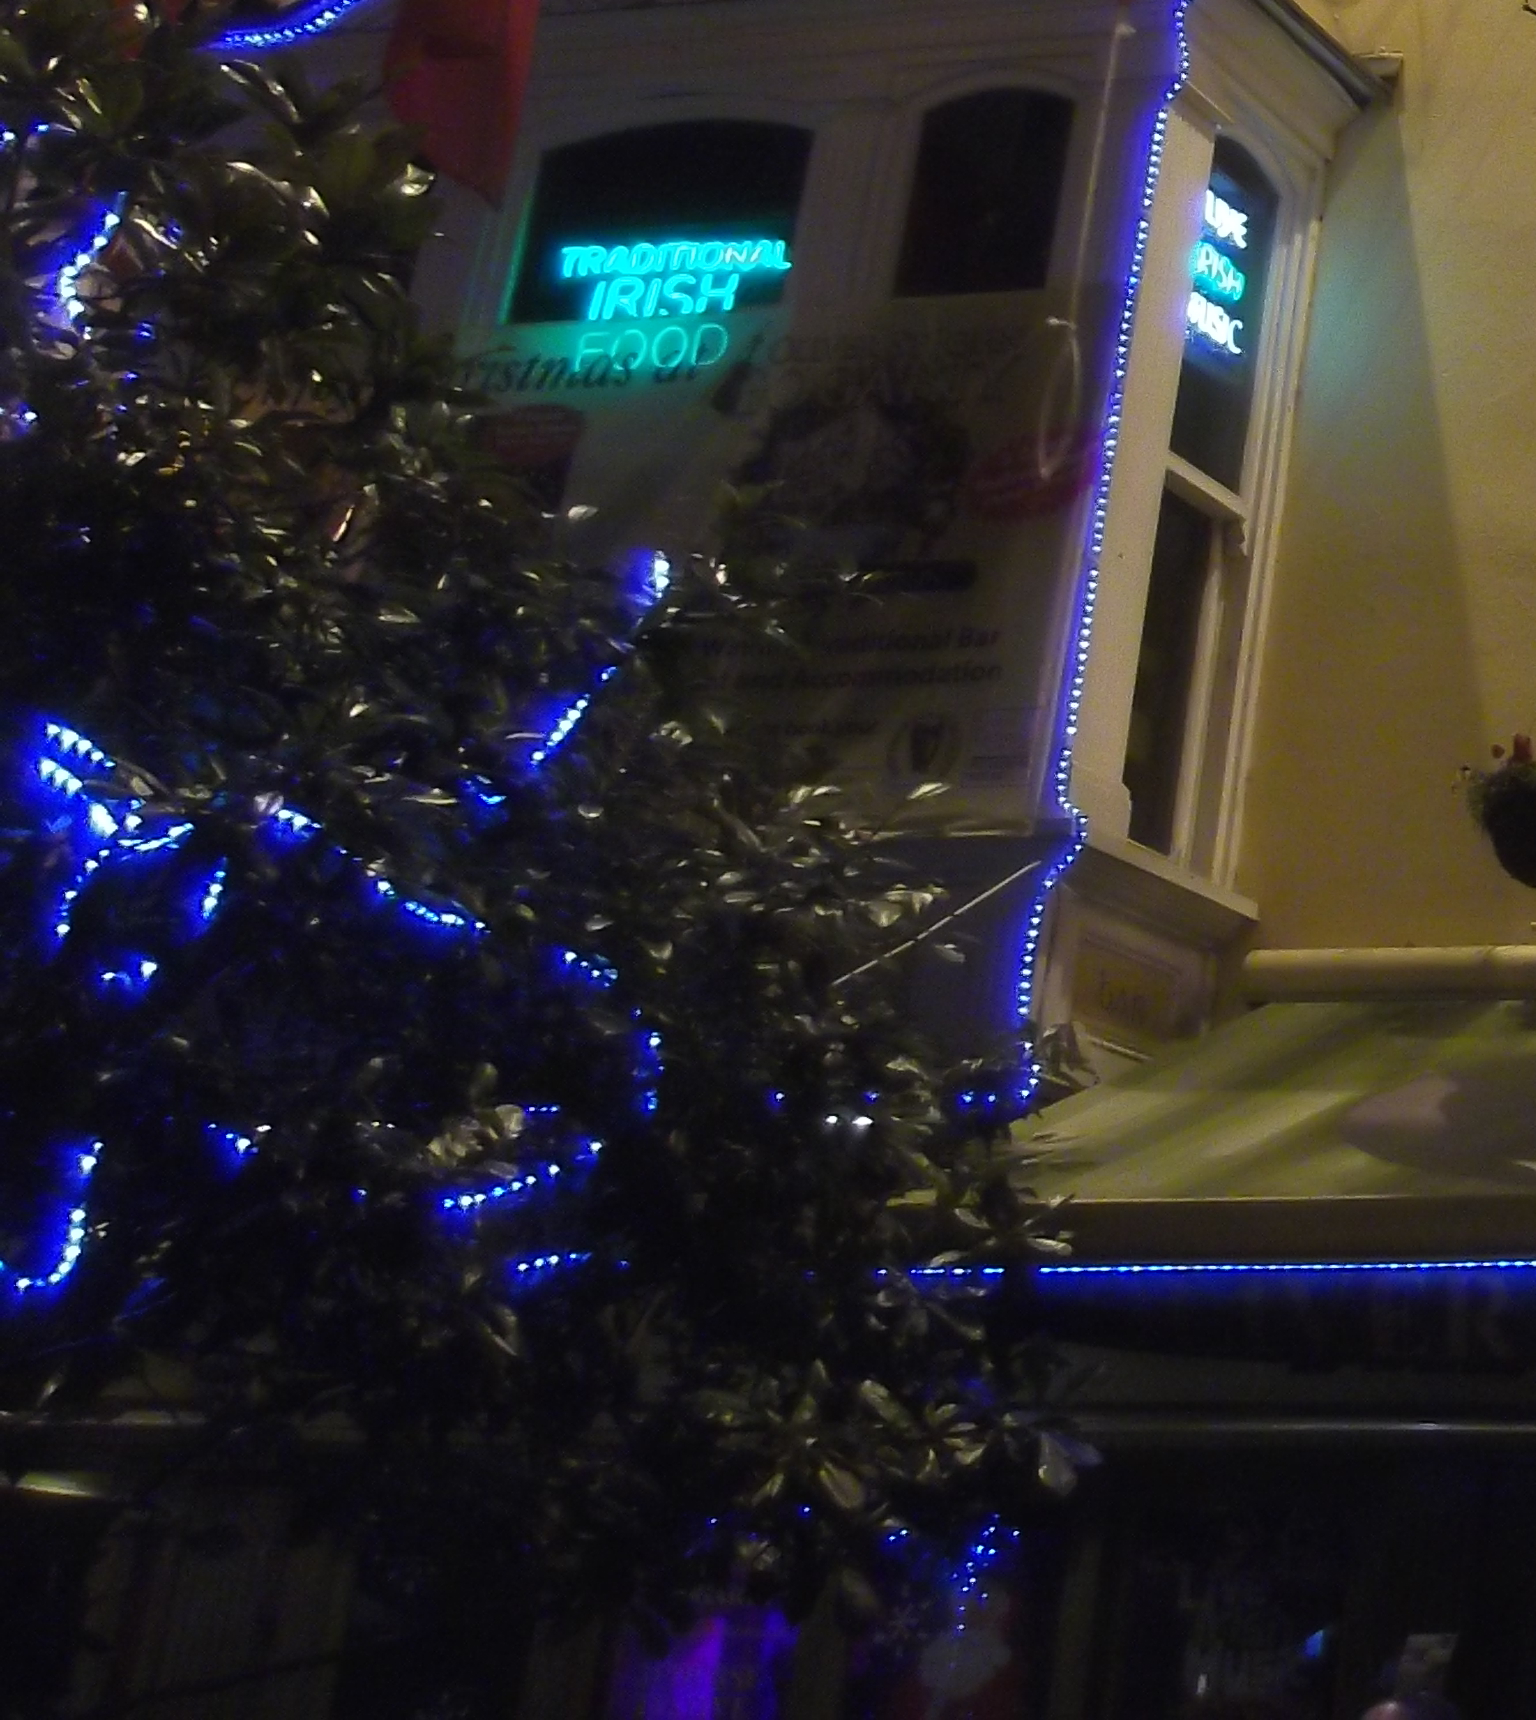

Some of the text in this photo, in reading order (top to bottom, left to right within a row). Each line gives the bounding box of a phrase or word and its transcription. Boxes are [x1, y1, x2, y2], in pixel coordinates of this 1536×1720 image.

[561, 239, 793, 279] TRADITIONAL
[587, 273, 740, 321] IRISH
[571, 322, 729, 374] FOOD
